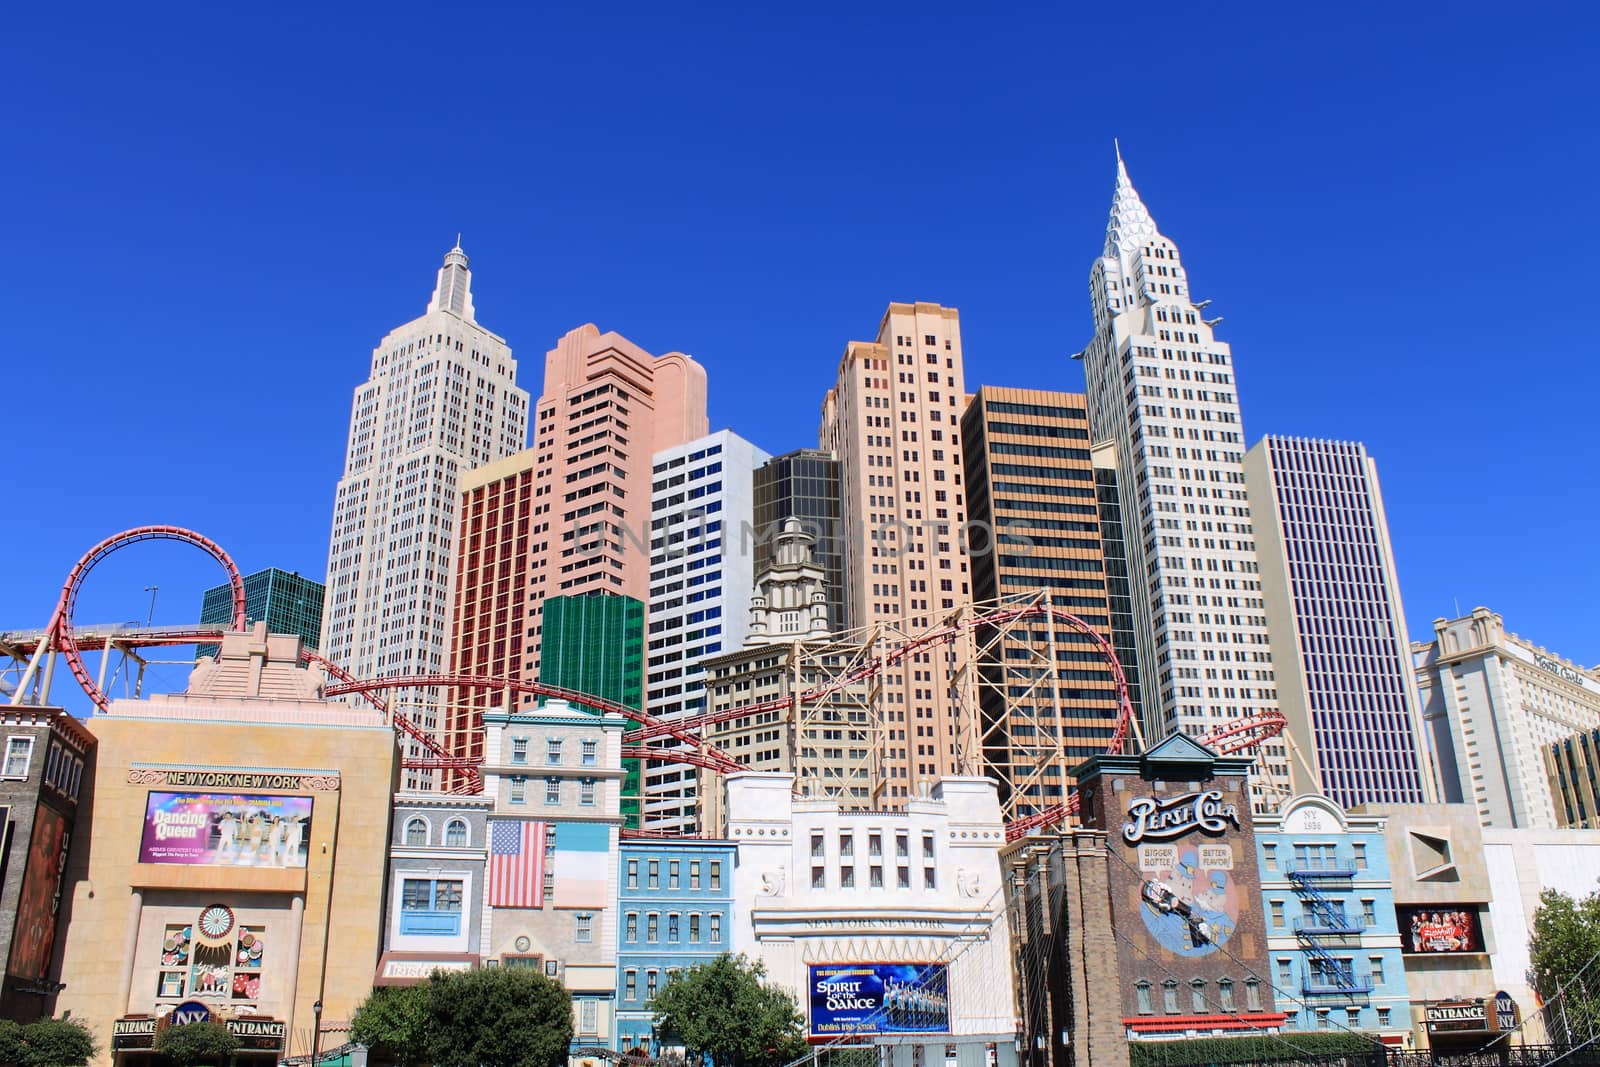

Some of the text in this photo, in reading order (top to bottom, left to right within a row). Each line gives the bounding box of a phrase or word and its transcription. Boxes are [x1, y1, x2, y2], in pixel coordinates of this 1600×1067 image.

[1534, 652, 1583, 686] Monte Carlo
[154, 809, 208, 828] Dancing
[155, 823, 197, 840] Queen
[1144, 848, 1173, 857] BIGGER
[1202, 848, 1227, 857] BETTER
[817, 981, 862, 996] SPIRIT
[826, 997, 876, 1011] DANCE
[1496, 1000, 1512, 1012] NY
[1428, 1008, 1484, 1019] ENTRANCE
[115, 1021, 155, 1033] ENTRANCE
[1499, 1014, 1516, 1028] NY
[227, 1023, 283, 1036] ENTRANCE
